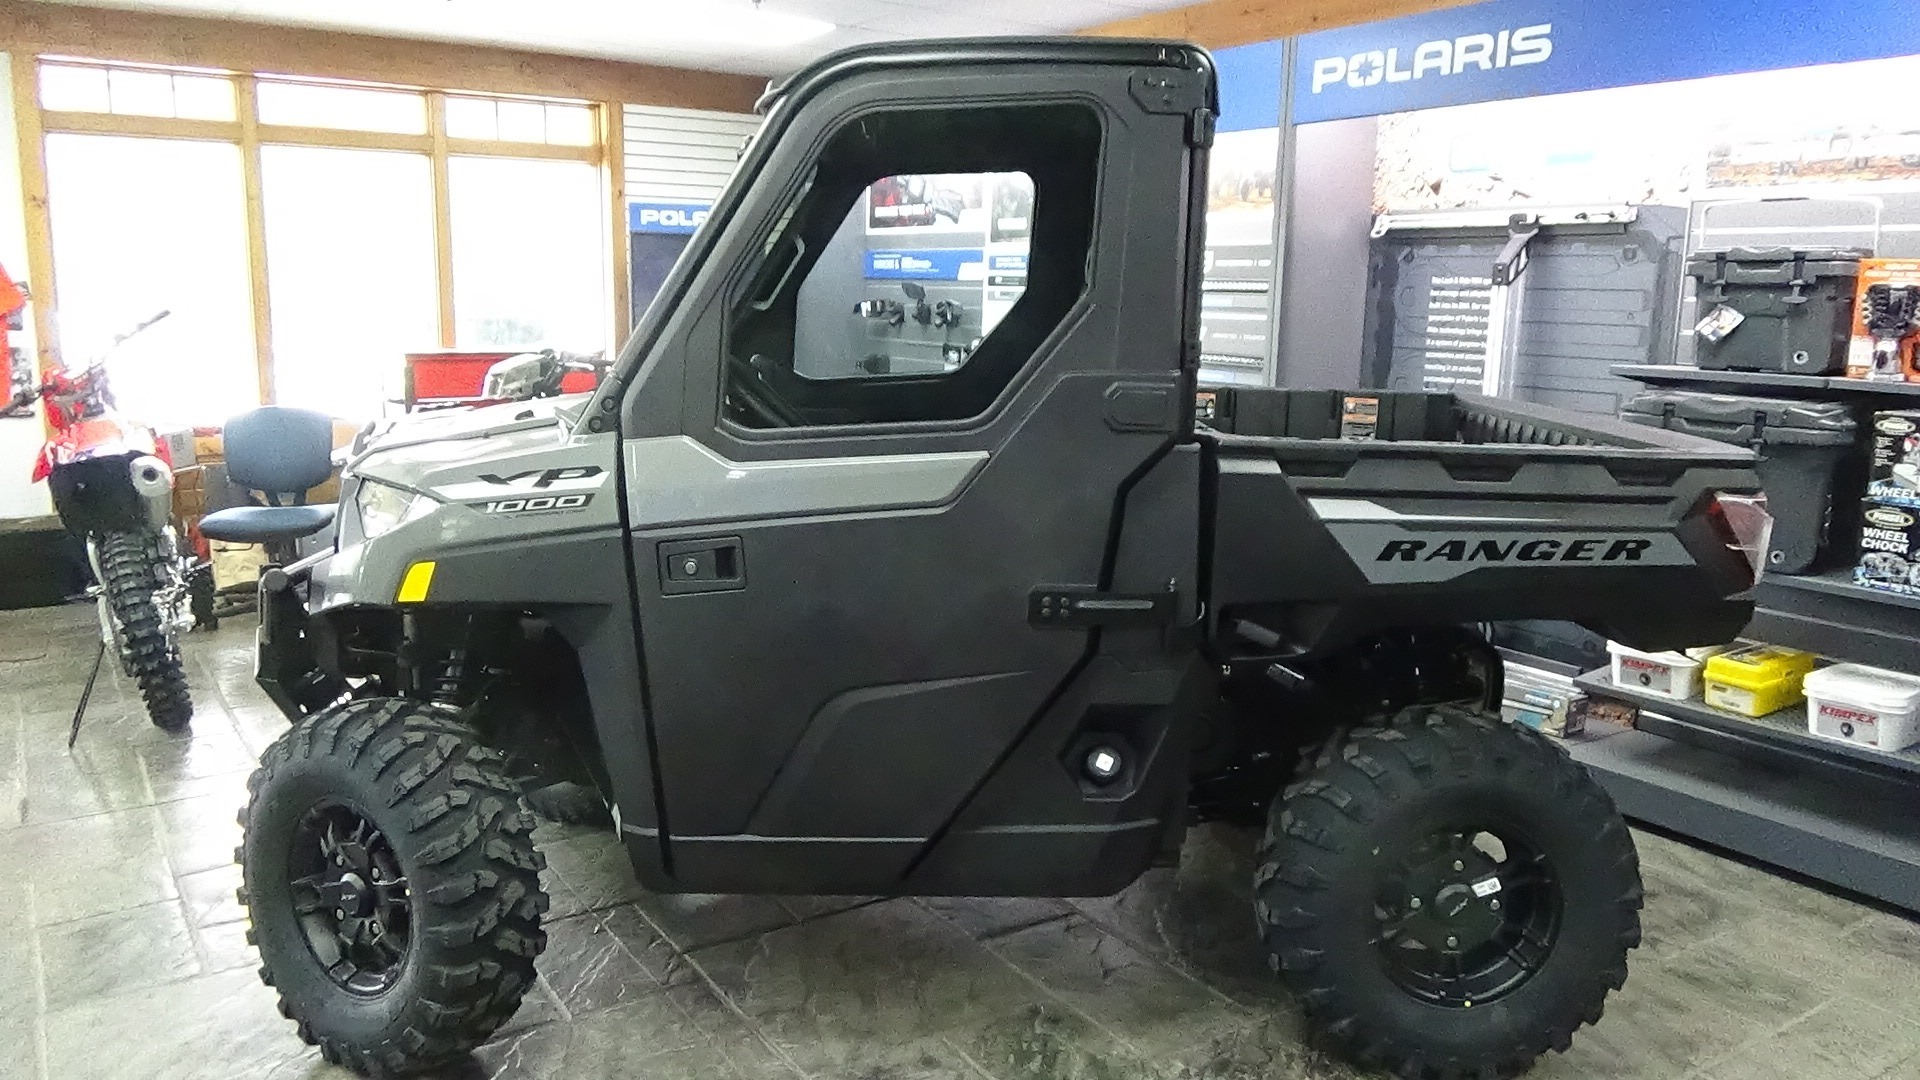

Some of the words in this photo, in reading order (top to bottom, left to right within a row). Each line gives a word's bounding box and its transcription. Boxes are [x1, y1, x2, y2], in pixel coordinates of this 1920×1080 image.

[1312, 24, 1552, 94] POLARIS
[1868, 485, 1916, 498] WHEEL
[485, 495, 587, 513] 1000
[1862, 527, 1910, 544] WHEEL
[1375, 539, 1653, 562] RANGER
[1861, 538, 1910, 555] CHOCK
[1819, 704, 1878, 726] KIMPEX
